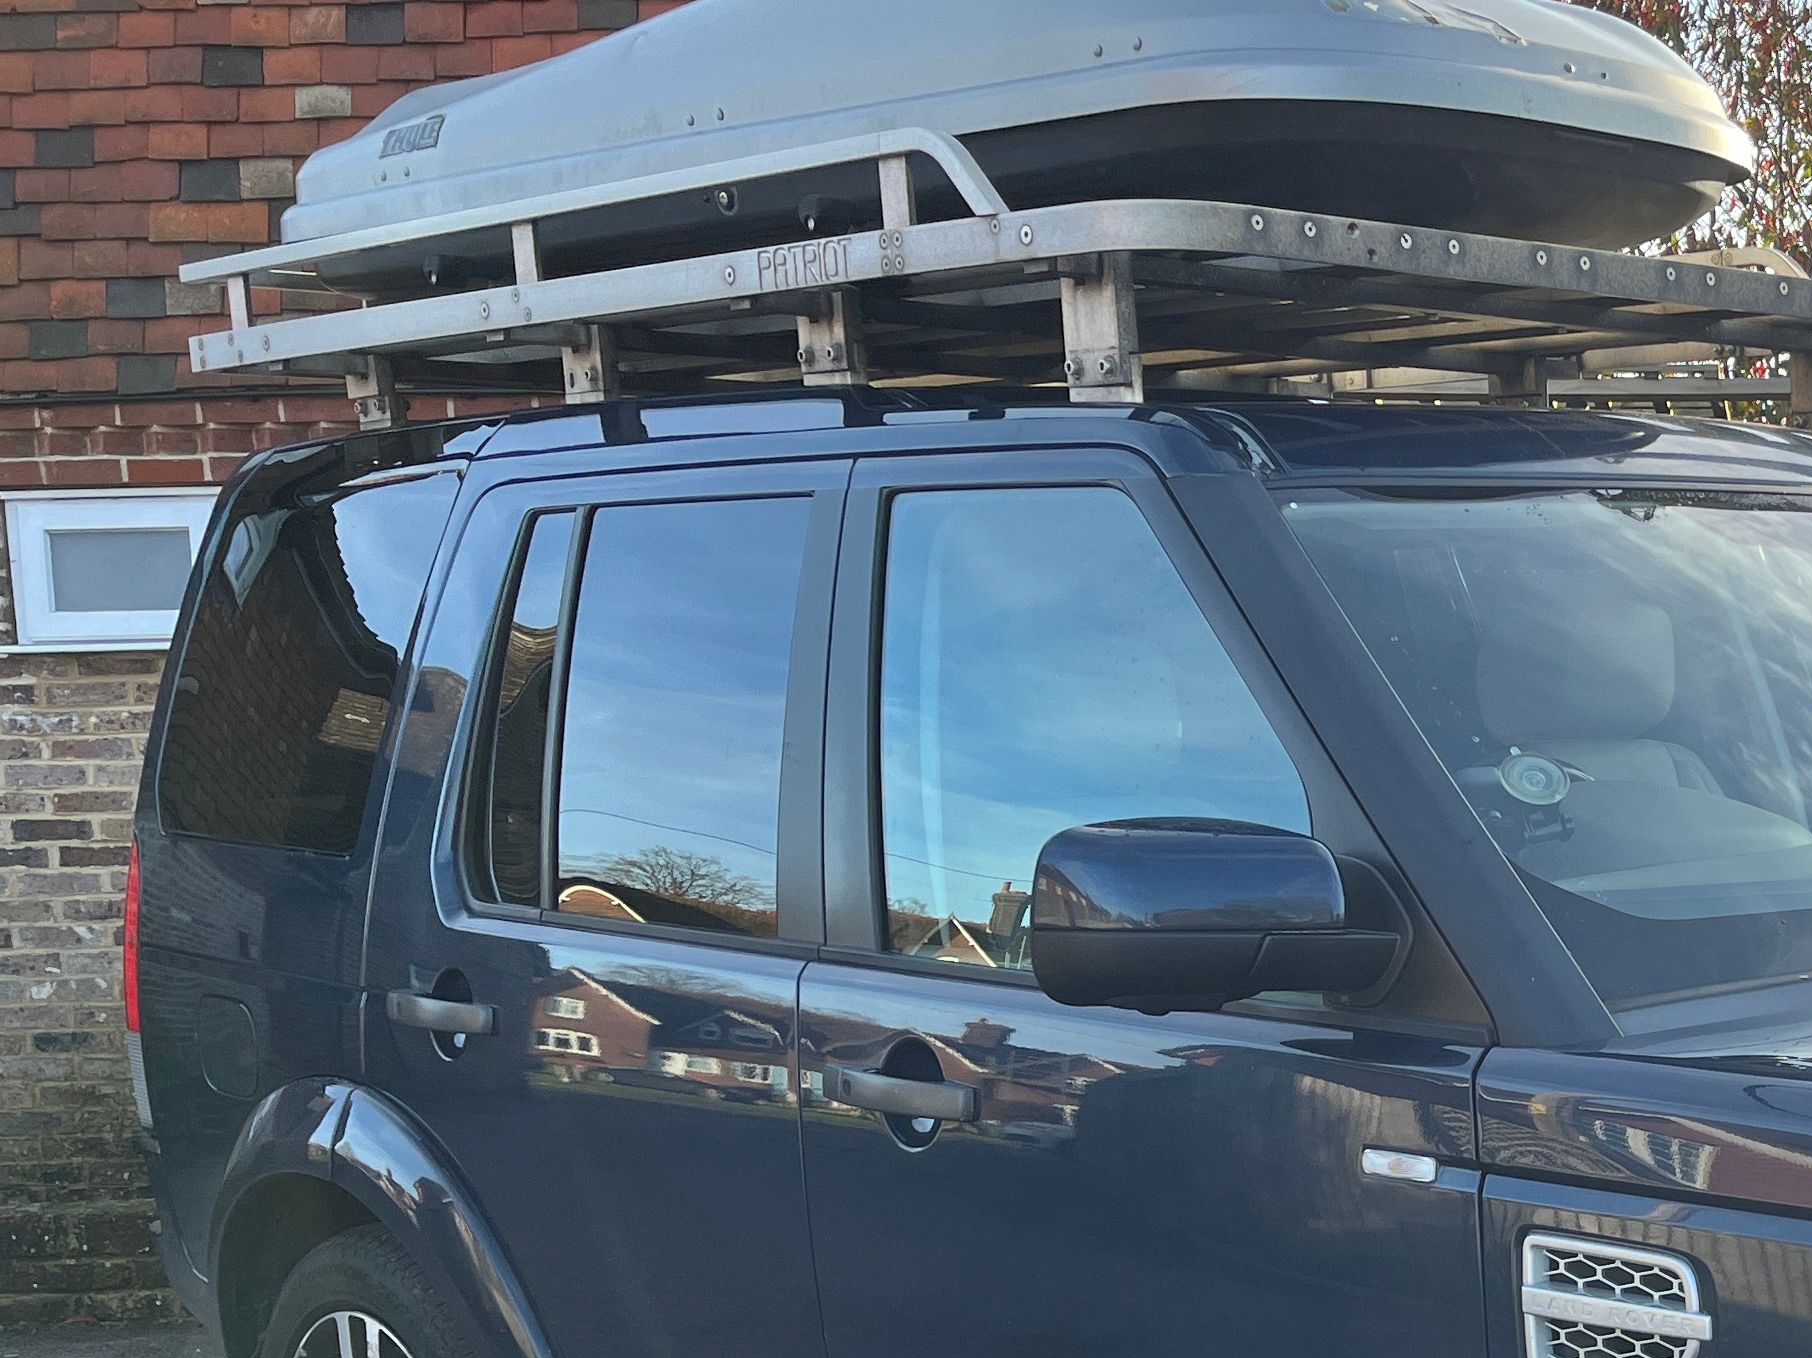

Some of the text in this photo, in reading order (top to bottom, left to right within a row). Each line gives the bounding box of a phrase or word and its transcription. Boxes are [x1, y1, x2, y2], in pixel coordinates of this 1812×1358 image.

[757, 238, 852, 292] PATRIOT
[1531, 1294, 1695, 1337] LAND ROVER
